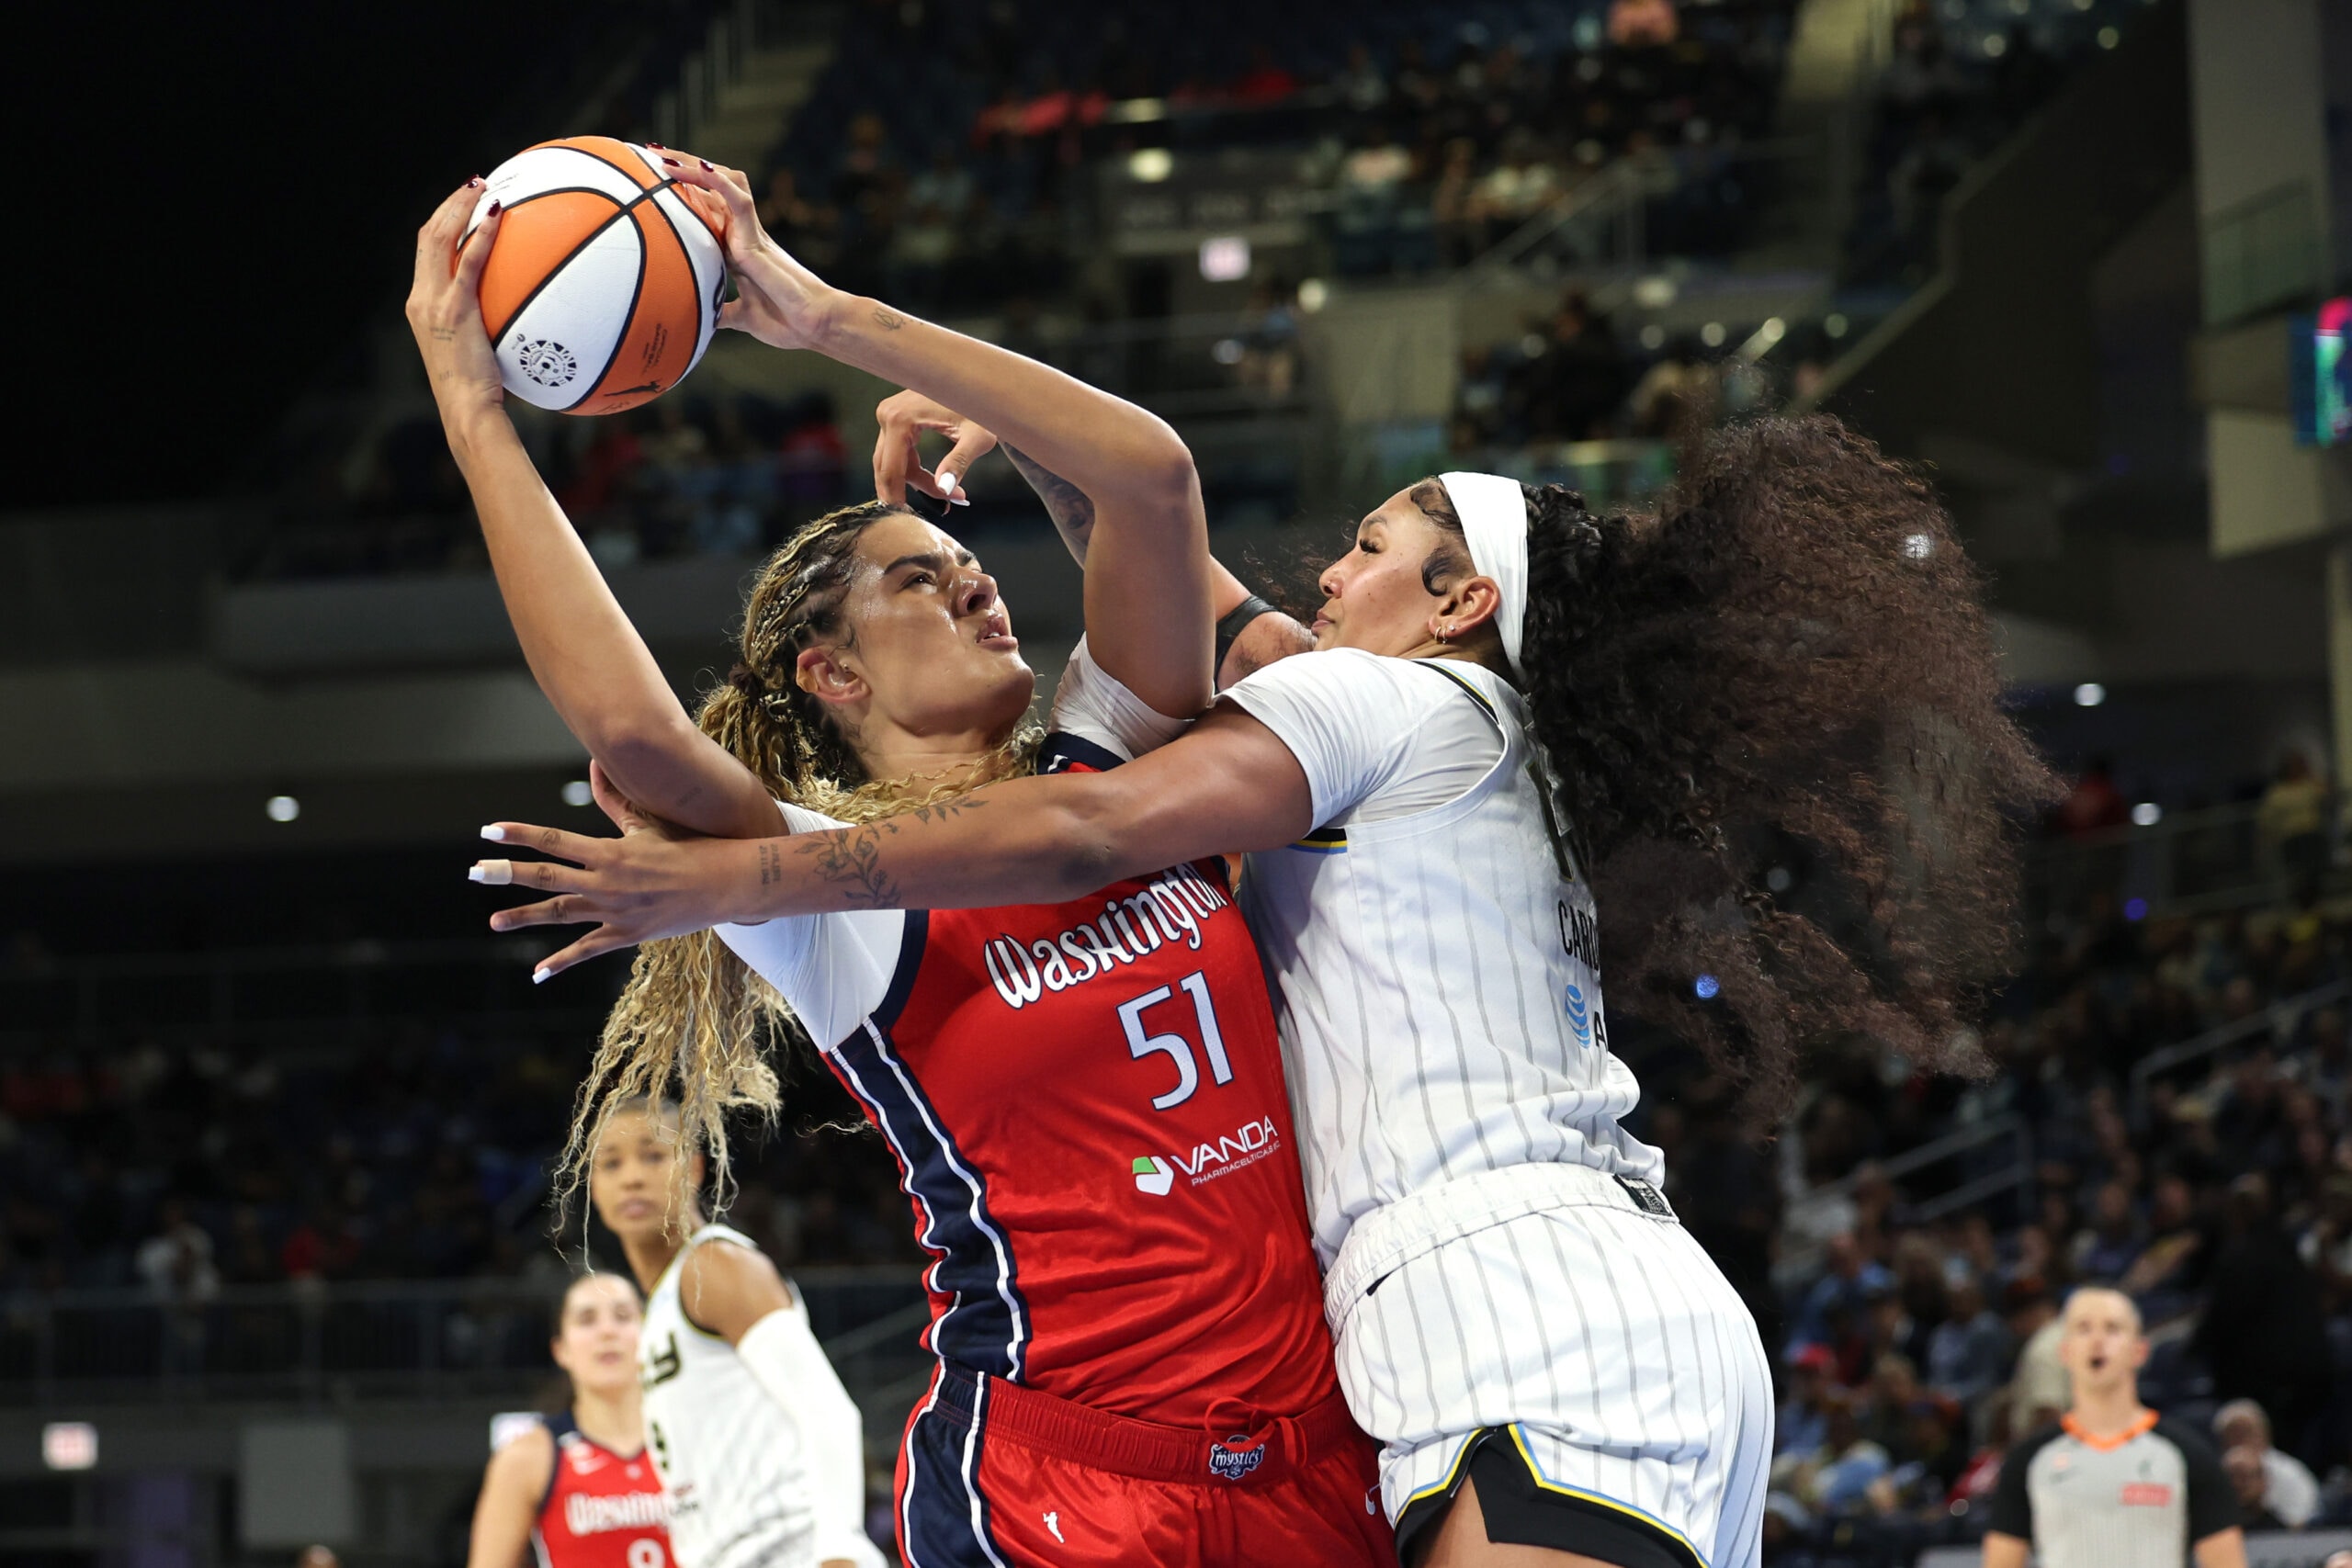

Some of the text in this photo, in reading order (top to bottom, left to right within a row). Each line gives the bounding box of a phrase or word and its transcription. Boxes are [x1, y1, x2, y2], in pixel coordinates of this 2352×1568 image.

[984, 864, 1227, 1009] Washington
[1115, 969, 1235, 1111] 51
[1170, 1114, 1279, 1176] VANDA
